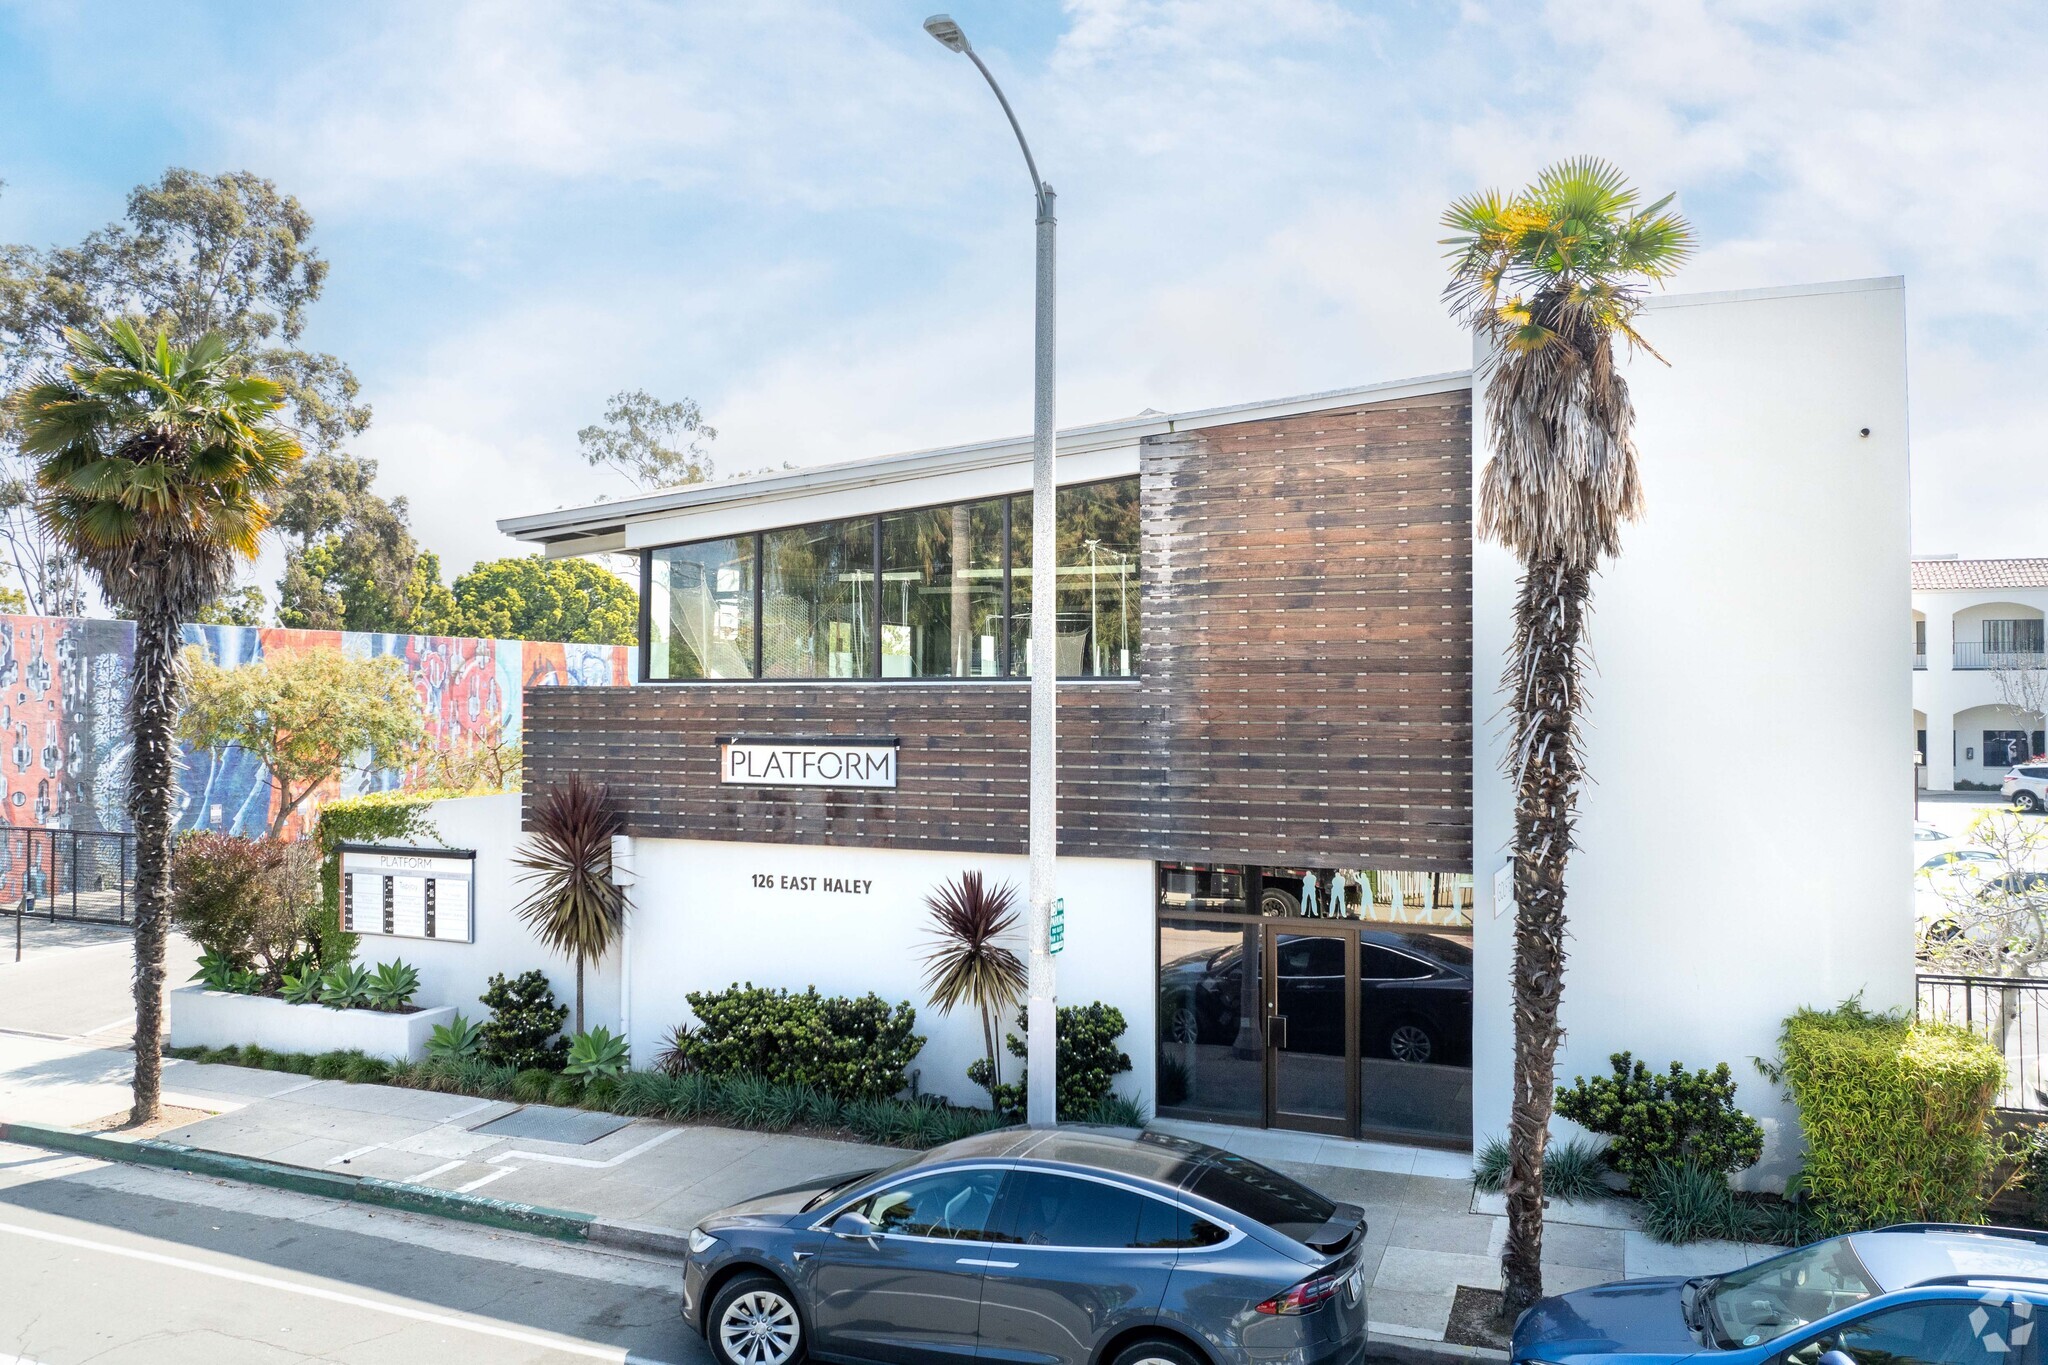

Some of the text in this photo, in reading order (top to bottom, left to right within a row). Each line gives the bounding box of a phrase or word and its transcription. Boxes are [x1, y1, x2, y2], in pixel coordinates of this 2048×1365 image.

[731, 750, 889, 780] PLATFORM
[380, 855, 432, 869] PLATFORM
[751, 873, 873, 895] 126 EAST HALEY
